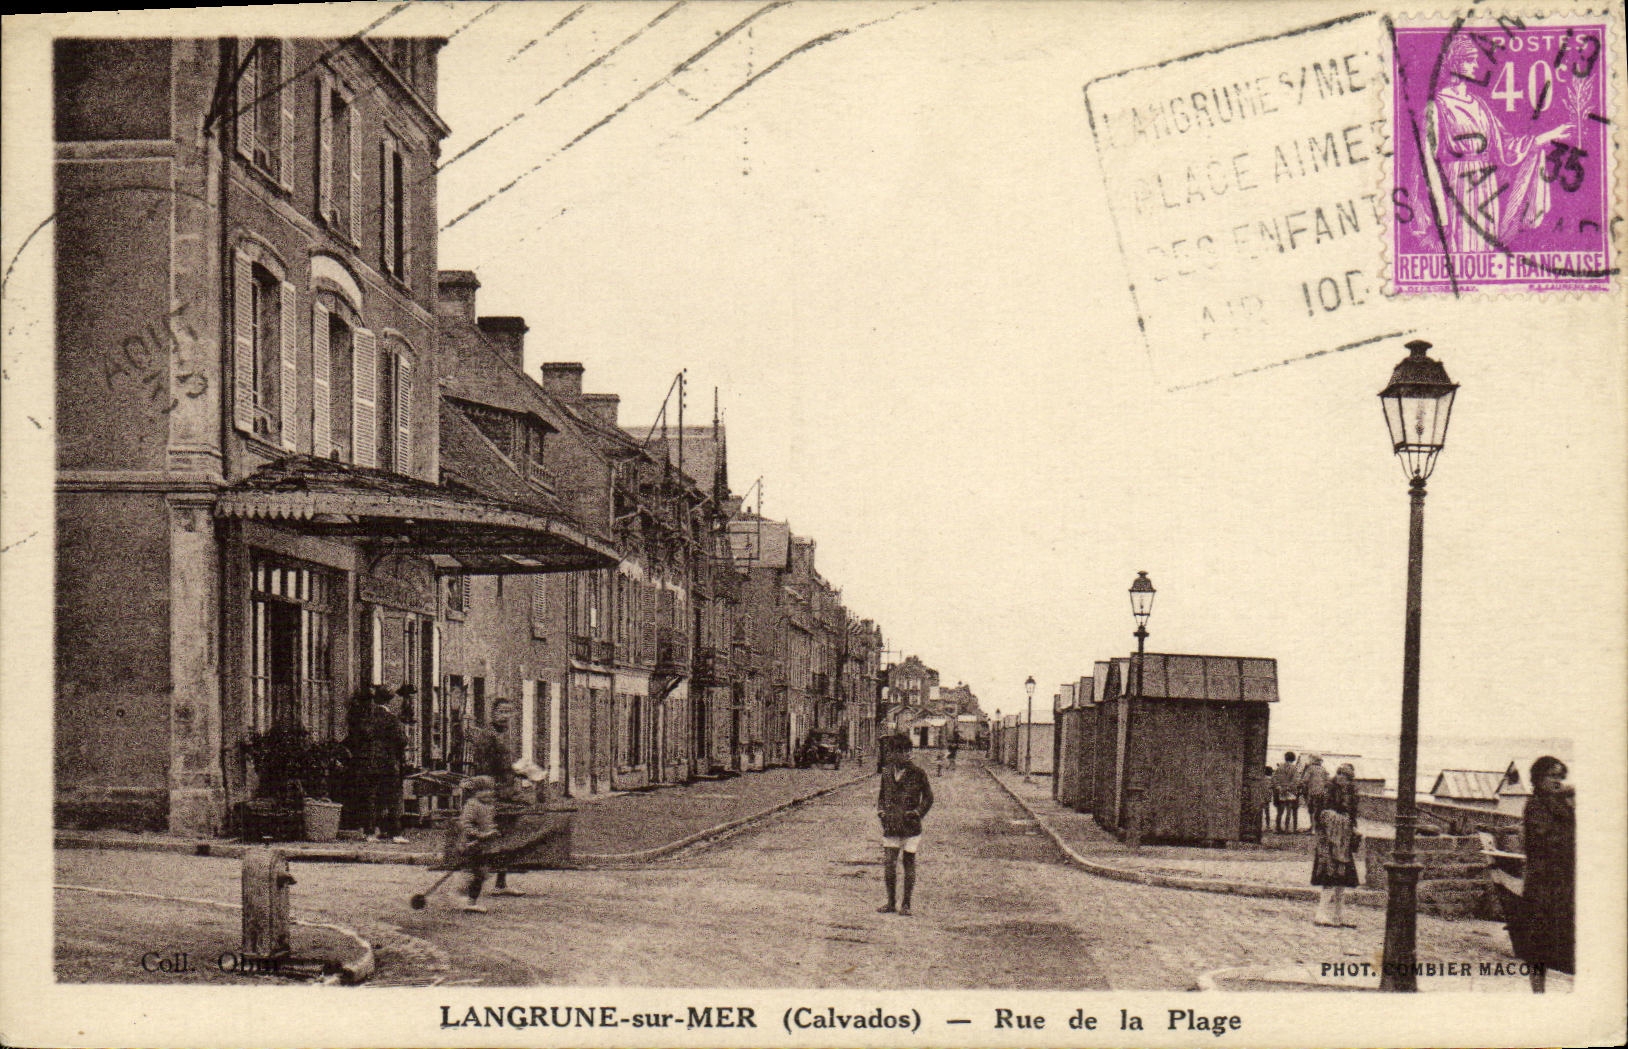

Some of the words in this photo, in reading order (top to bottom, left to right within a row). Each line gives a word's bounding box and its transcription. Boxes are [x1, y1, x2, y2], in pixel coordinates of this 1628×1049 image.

[1493, 34, 1589, 53] POSTES
[1539, 139, 1590, 194] 35
[1398, 254, 1498, 281] REPUBLIQUE
